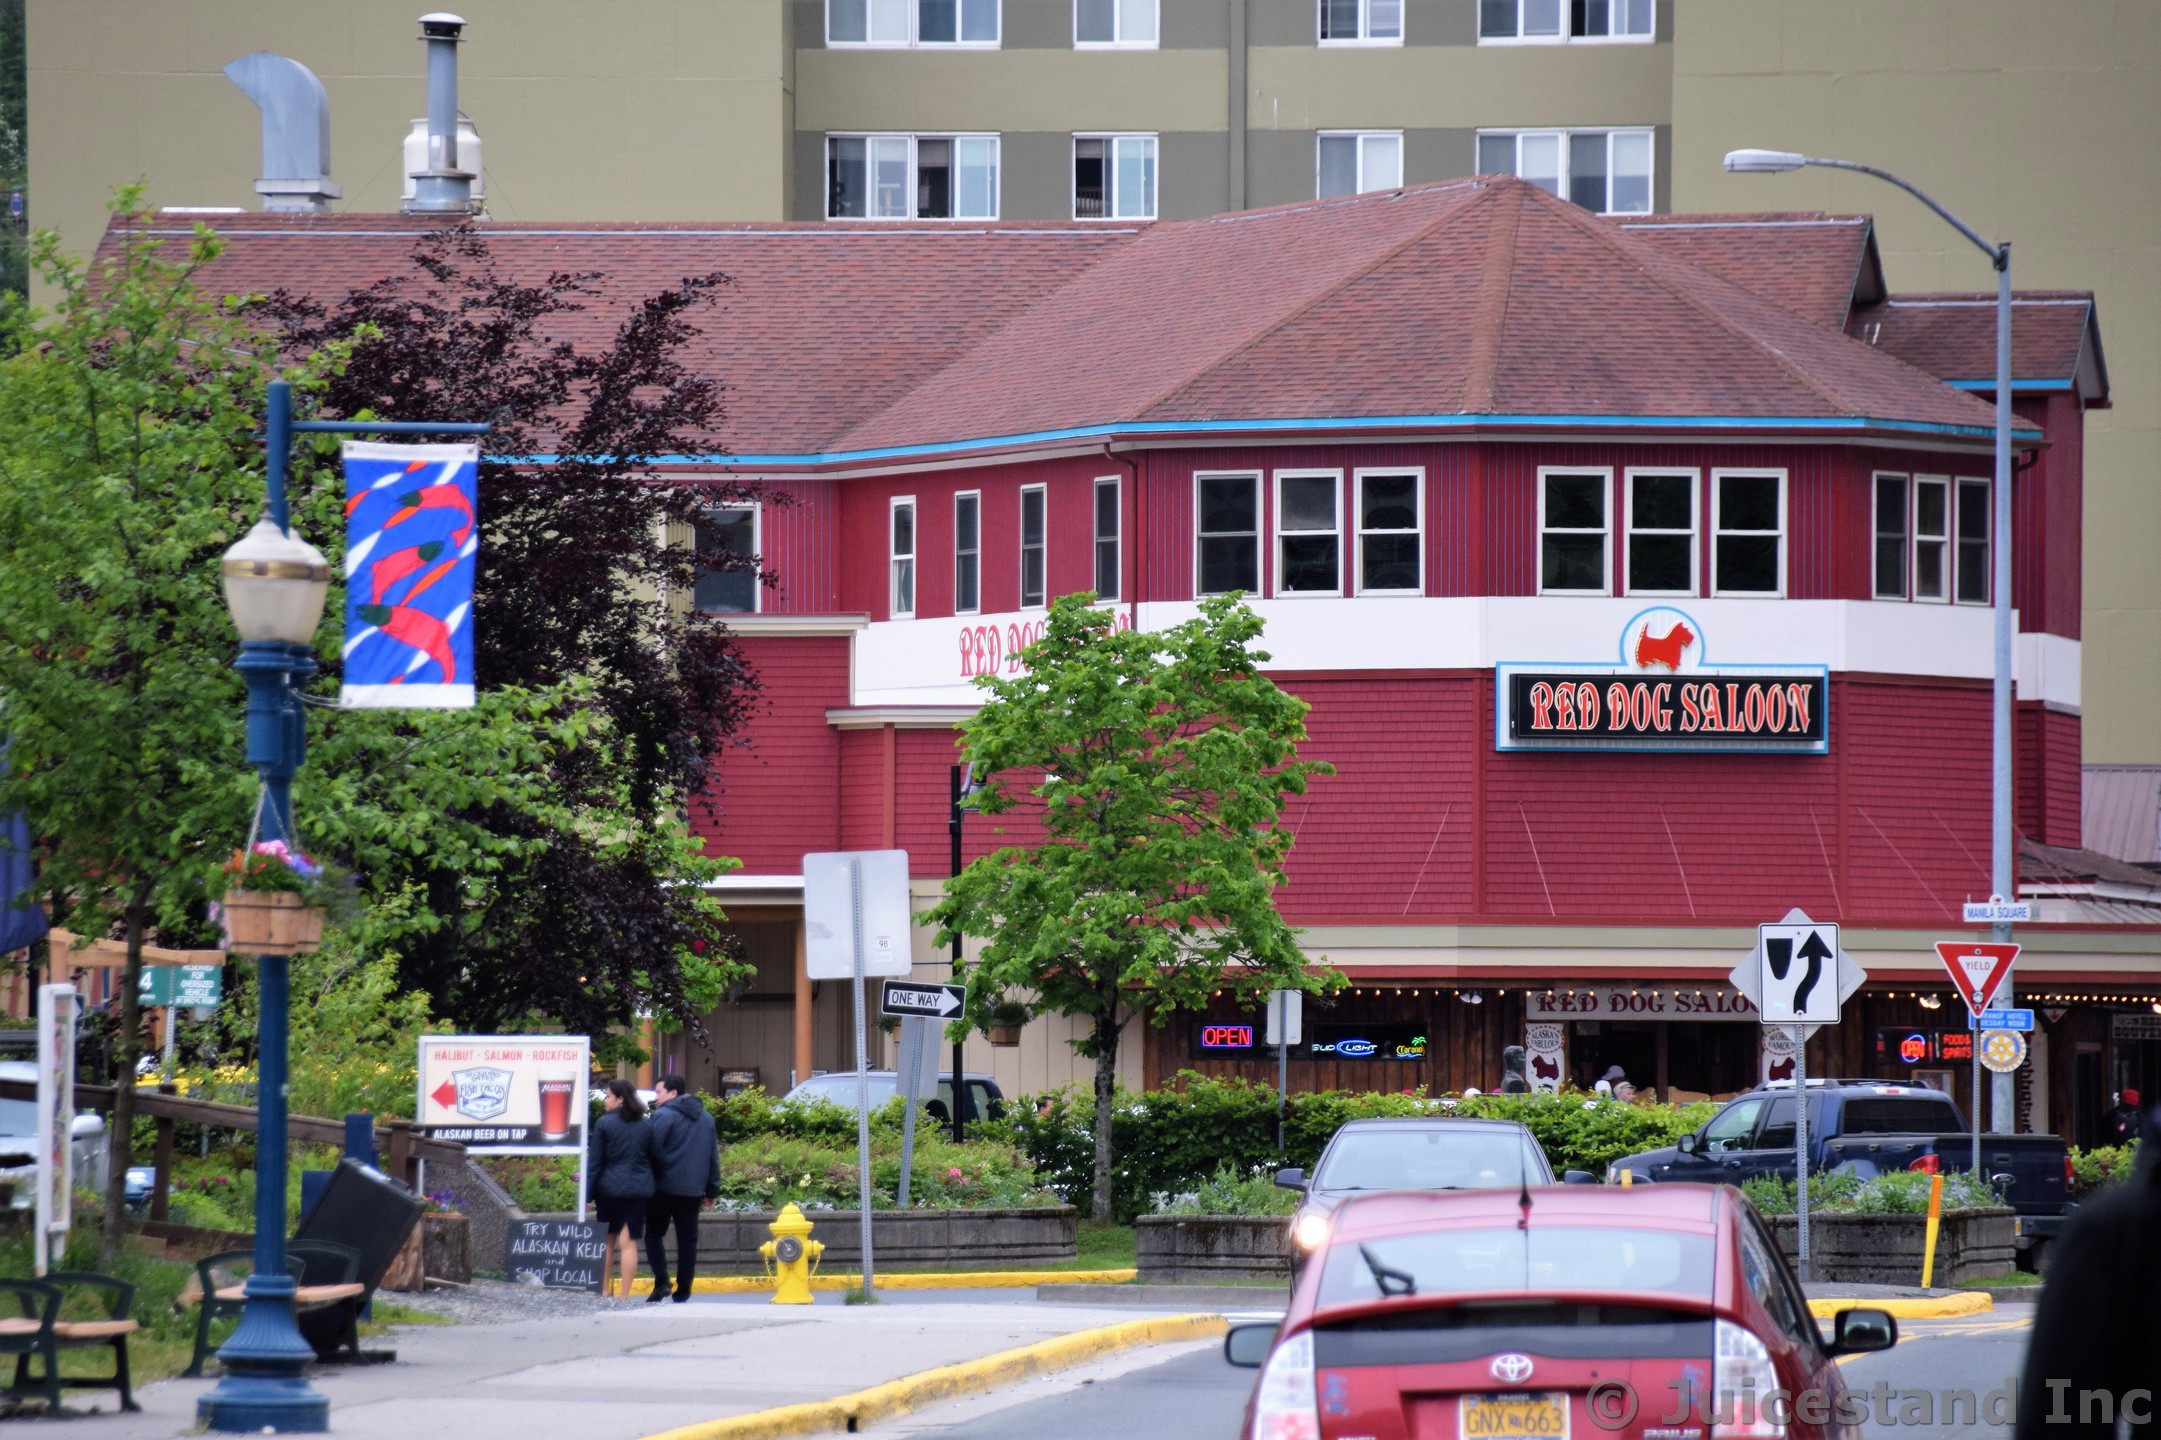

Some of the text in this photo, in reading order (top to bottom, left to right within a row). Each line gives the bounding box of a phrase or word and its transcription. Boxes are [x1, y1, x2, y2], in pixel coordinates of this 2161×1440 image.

[959, 625, 1002, 677] RED
[1530, 681, 1813, 734] RED DOG SALOON
[1967, 907, 2028, 918] MANILA SQUARE
[878, 940, 889, 949] 98
[1965, 961, 1991, 971] YIELD
[181, 980, 214, 988] OVERSIZED
[185, 988, 210, 996] VEHICLE
[891, 991, 941, 1007] ONE WAY
[1536, 993, 1760, 1014] RED DOG SALO
[1204, 1028, 1250, 1045] OPEN
[1345, 1044, 1378, 1052] LIGHT
[434, 1050, 579, 1061] HALIBUT SALMON ROCKFISH
[460, 1083, 506, 1098] FISH TACOS
[433, 1129, 527, 1140] ALASKAN BEER ON TAP
[523, 1222, 593, 1239] TRY WILD
[512, 1239, 607, 1259] ALASKAN KELP
[544, 1256, 565, 1266] and
[555, 1268, 599, 1285] LOCAL
[1466, 1406, 1565, 1434] GNX 663
[1643, 1428, 1702, 1440] PRIUS
